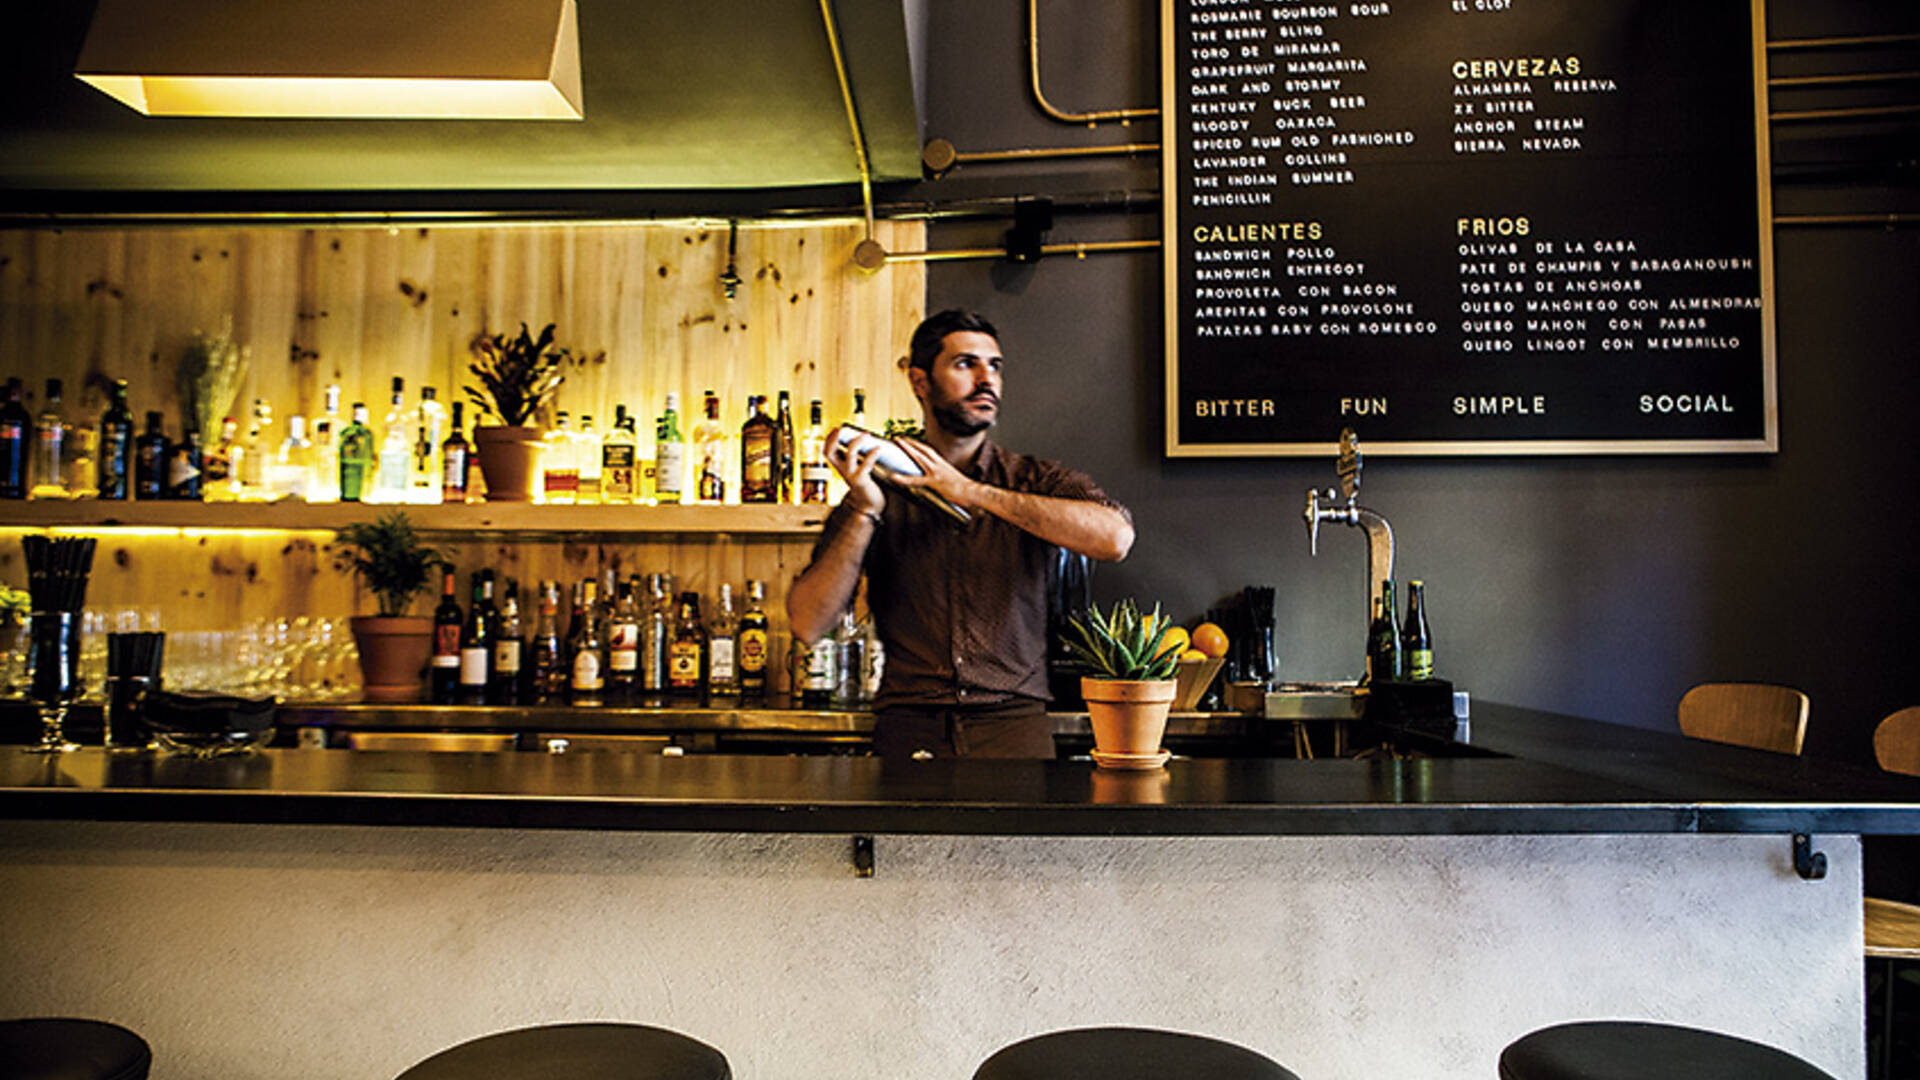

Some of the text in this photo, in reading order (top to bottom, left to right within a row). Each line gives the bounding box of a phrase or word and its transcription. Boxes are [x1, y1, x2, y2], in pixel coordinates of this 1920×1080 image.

[1272, 6, 1338, 20] BOURBON
[1350, 2, 1390, 16] SOUR
[1191, 24, 1323, 42] THE BERRY SLING
[1191, 41, 1341, 60] TORO DE MIRAMAR
[1191, 59, 1367, 79] GRAPEFRUIT MARGARITA
[1452, 56, 1581, 80] CERVEZAS
[1191, 79, 1341, 97] DARK AND STORMY
[1453, 79, 1617, 96] ALHAMBRA RESERVA
[1273, 97, 1311, 111] BUCK
[1329, 95, 1366, 109] BEER
[1485, 100, 1534, 114] BITTER
[1192, 115, 1336, 133] BLOODY OAXACA
[1454, 118, 1584, 134] ANCHOR STEAM
[1193, 131, 1414, 151] SPICED RUM OLD FASHIONED
[1454, 136, 1581, 153] SIERRA NEVADA
[1284, 151, 1347, 166] COLLINS
[1193, 170, 1354, 188] THE INDIAN SUMMER
[1193, 192, 1271, 206] PENICILLIN
[1193, 222, 1322, 243] CALIENTES
[1457, 217, 1530, 236] FRIOS
[1195, 247, 1335, 262] SANDWICH POLLO
[1458, 240, 1636, 256] OLIVAS DE LA CASA
[1196, 267, 1271, 281] SANDWICH
[1460, 262, 1496, 274] PATE
[1508, 261, 1526, 274] DE
[1610, 260, 1621, 272] Y
[1196, 283, 1397, 299] PROVOLETA CON BACON
[1461, 279, 1642, 295] TOSTAS DE ANCHOAS
[1195, 303, 1413, 318] AREPITAS CON PROVOLONE
[1526, 299, 1618, 312] MANCHEGO
[1628, 298, 1658, 311] CON
[1669, 297, 1763, 311] ALMENDRAS
[1197, 321, 1437, 336] PATATAS BABY CON ROMESCO
[1608, 318, 1642, 331] CON
[1660, 317, 1706, 330] PASAS
[1601, 338, 1633, 351] CON
[1647, 337, 1740, 350] MEMBRILLO
[1196, 394, 1733, 417] BITTER FUN SIMPLE SOCIAL
